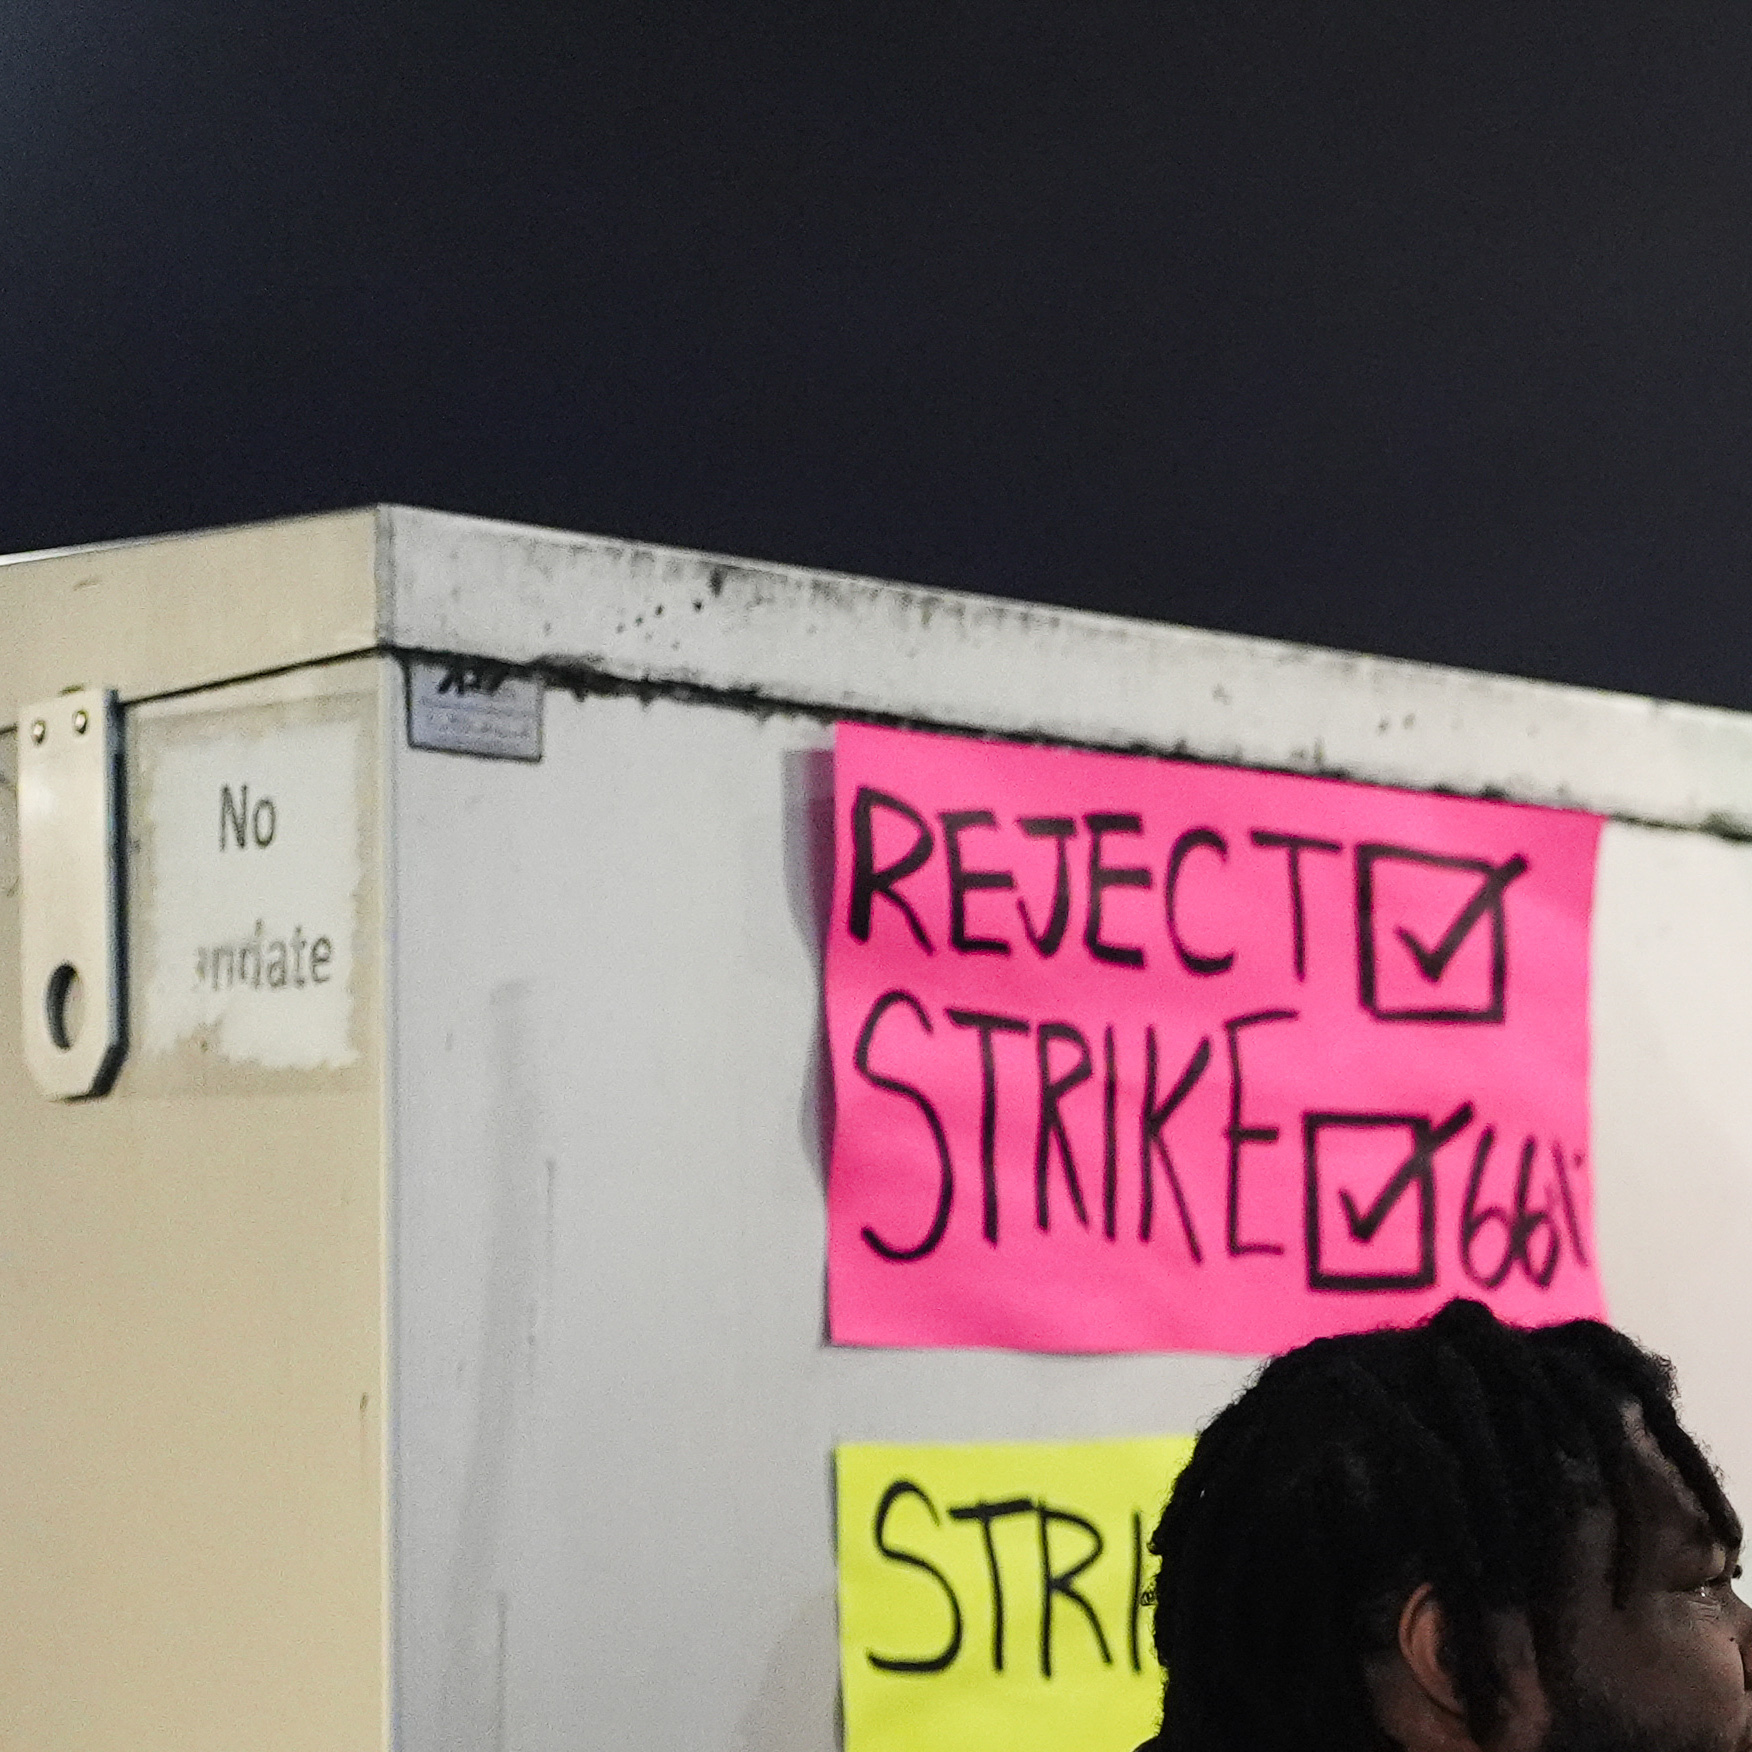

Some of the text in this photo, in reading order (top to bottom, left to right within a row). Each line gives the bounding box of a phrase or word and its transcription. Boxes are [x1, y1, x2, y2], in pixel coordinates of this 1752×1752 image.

[219, 783, 276, 851] No
[847, 784, 1348, 983] REJECT
[852, 989, 1300, 1265] STRIKE
